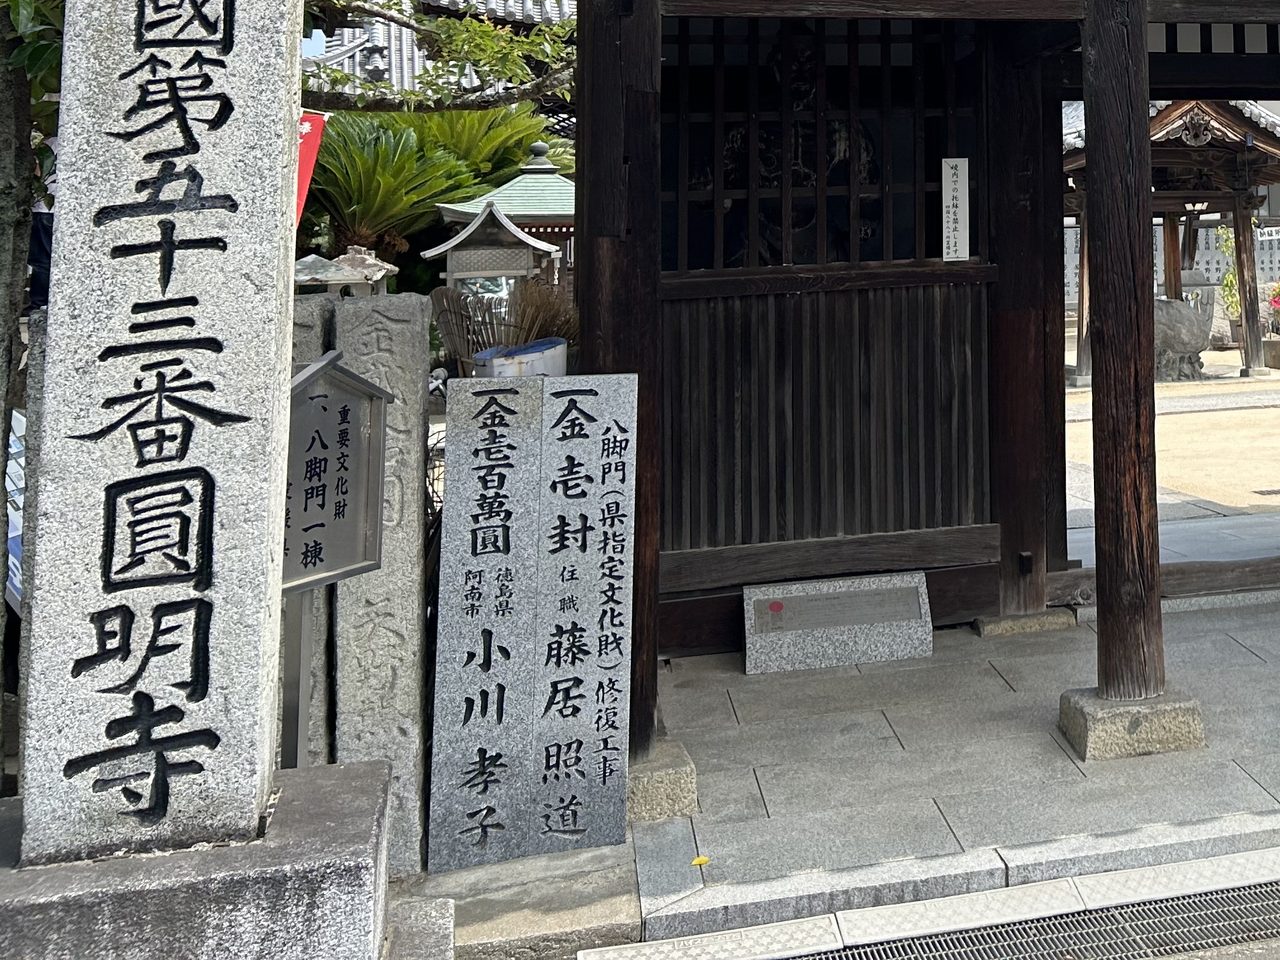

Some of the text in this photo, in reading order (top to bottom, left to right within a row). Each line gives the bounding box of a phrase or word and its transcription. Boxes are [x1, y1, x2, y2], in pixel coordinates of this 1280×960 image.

[300, 392, 330, 570] 一、八脚門一棟
[333, 403, 352, 521] 重要文化財
[470, 386, 520, 558] 一金壱百萬圓
[547, 387, 599, 556] 一金壱封
[462, 568, 485, 620] 阿南市
[493, 566, 515, 617] 徳島県
[558, 564, 580, 614] 住職
[456, 626, 512, 848] 小川孝子
[540, 620, 593, 838] 藤居照道
